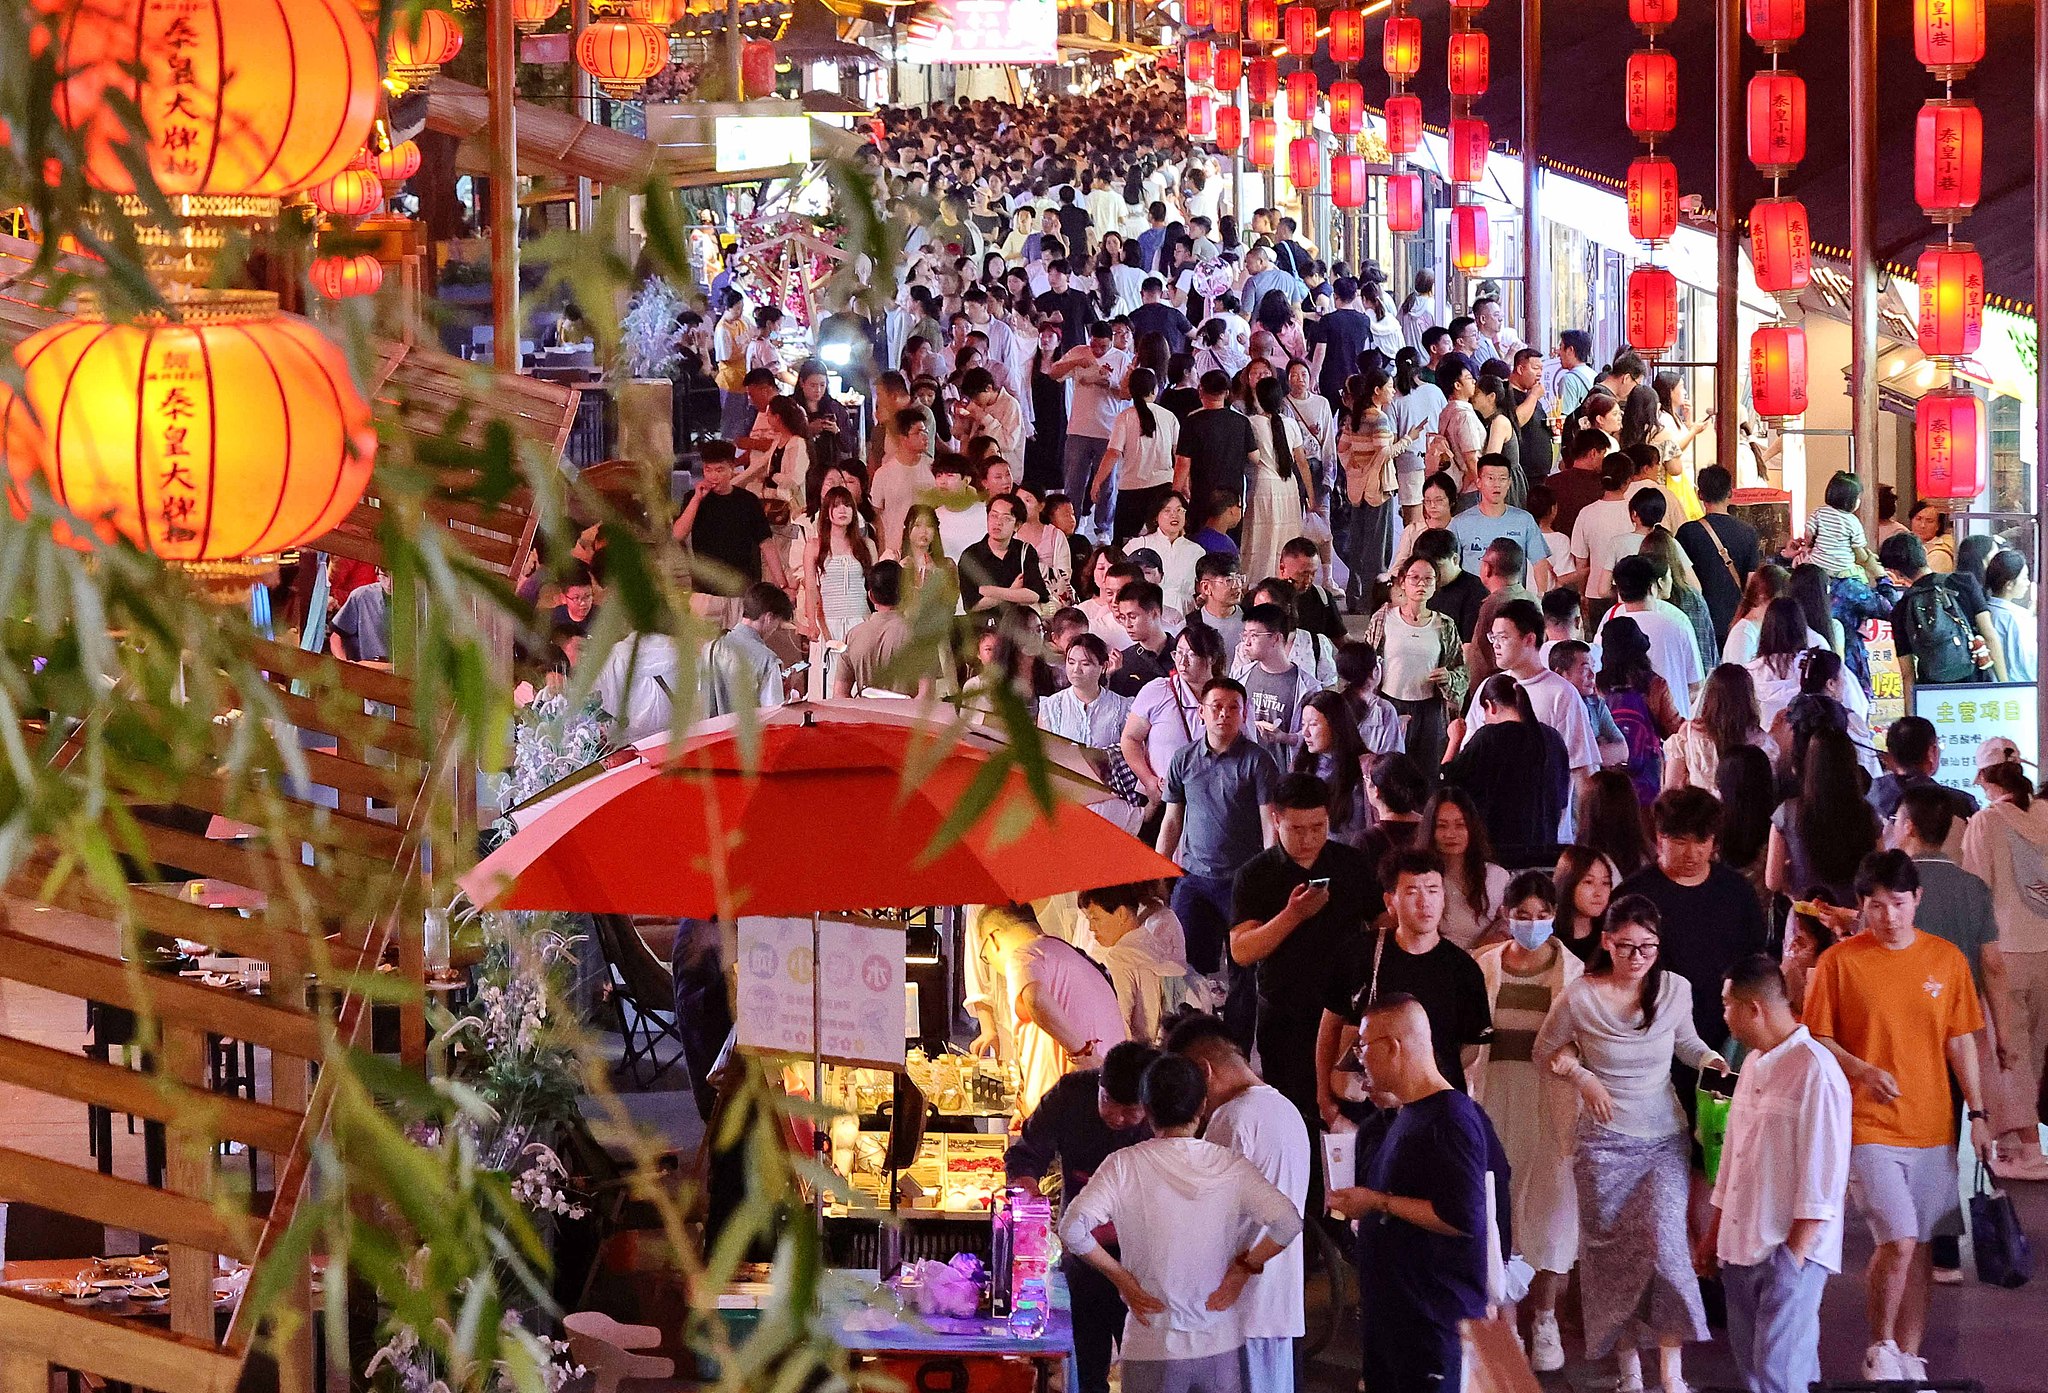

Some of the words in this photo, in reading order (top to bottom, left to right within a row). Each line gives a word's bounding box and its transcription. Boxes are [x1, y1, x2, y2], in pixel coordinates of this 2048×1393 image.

[1938, 128, 1960, 191] 秦皇小巷
[1789, 220, 1806, 273] 秦皇小巷
[1920, 276, 1937, 337] 秦皇小巷
[1965, 274, 1981, 336] 秦皇小巷
[1929, 418, 1951, 481] 秦皇小巷
[1936, 700, 2021, 724] 主营项目
